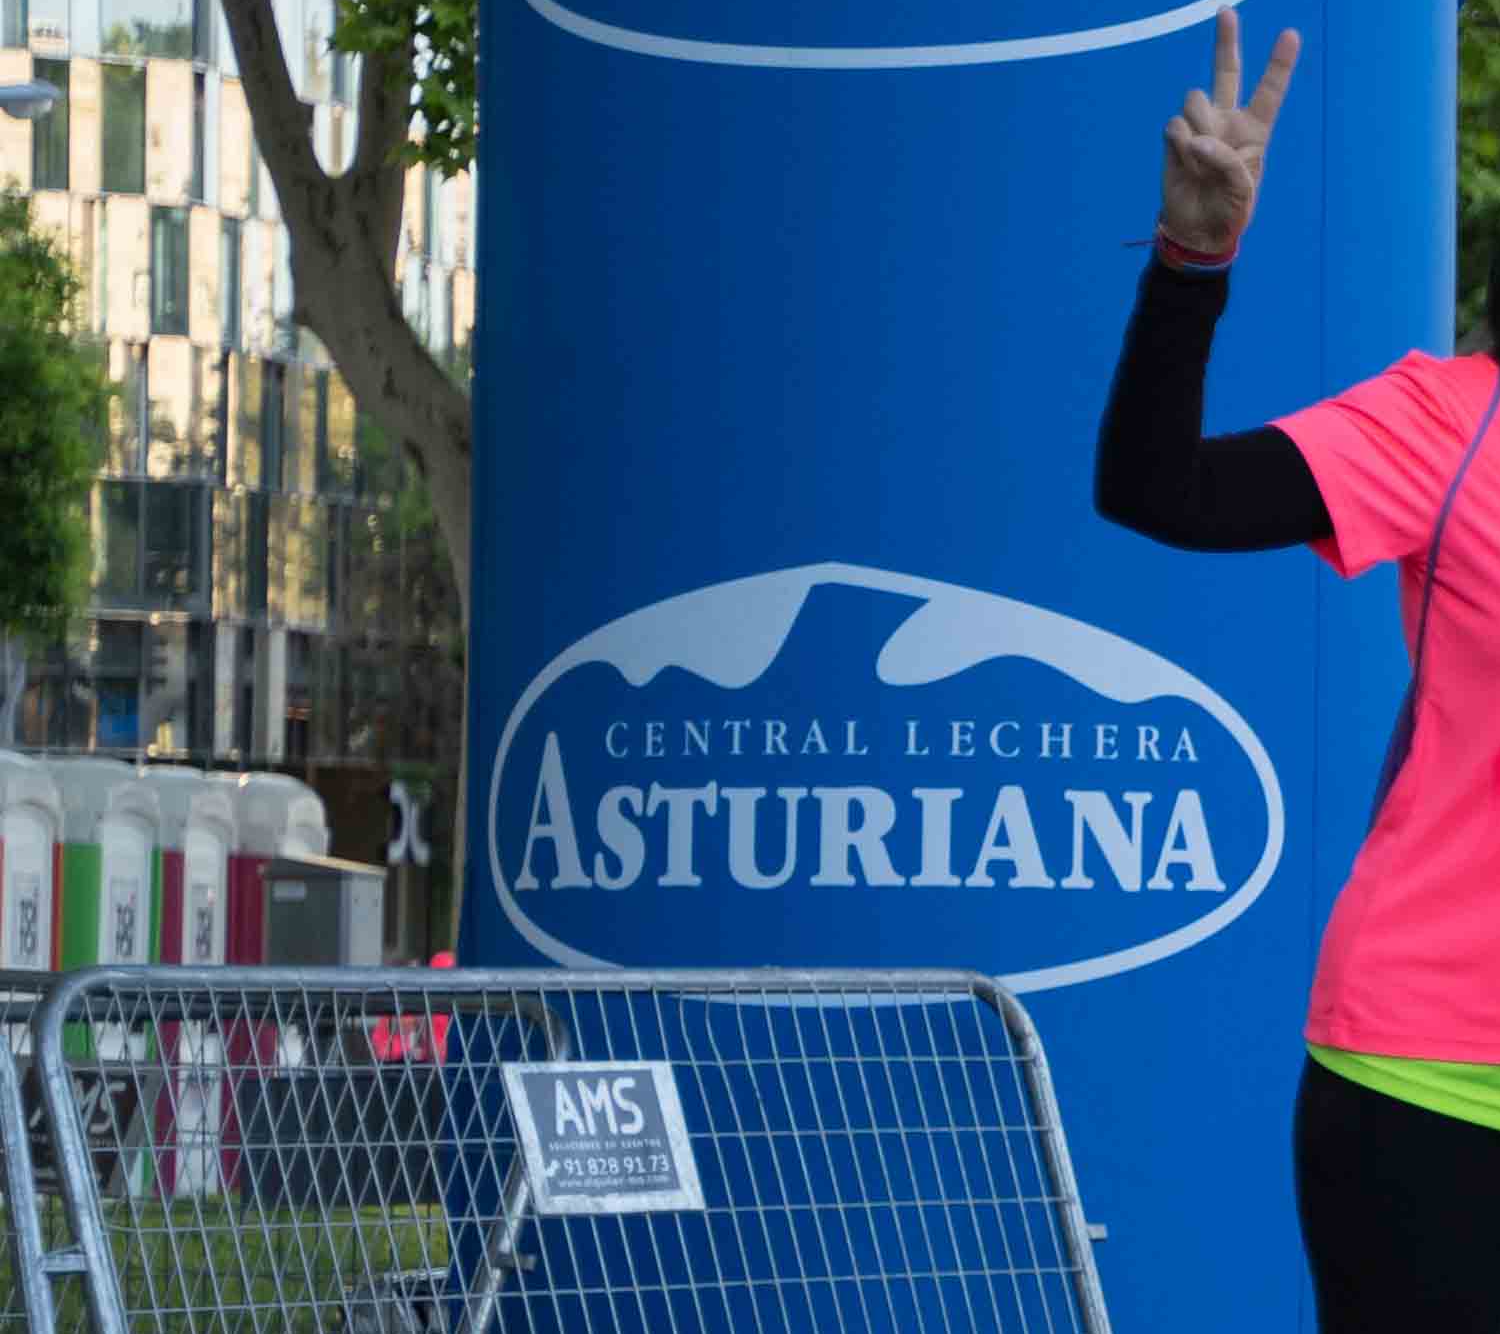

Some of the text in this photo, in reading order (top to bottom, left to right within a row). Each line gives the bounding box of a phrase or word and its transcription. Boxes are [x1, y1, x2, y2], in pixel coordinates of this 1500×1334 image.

[605, 718, 1199, 763] CENTRAL LECHERA
[513, 730, 1228, 893] ASTURIANA
[555, 1077, 645, 1136] AMS
[563, 1153, 670, 1177] 91 828 91 73
